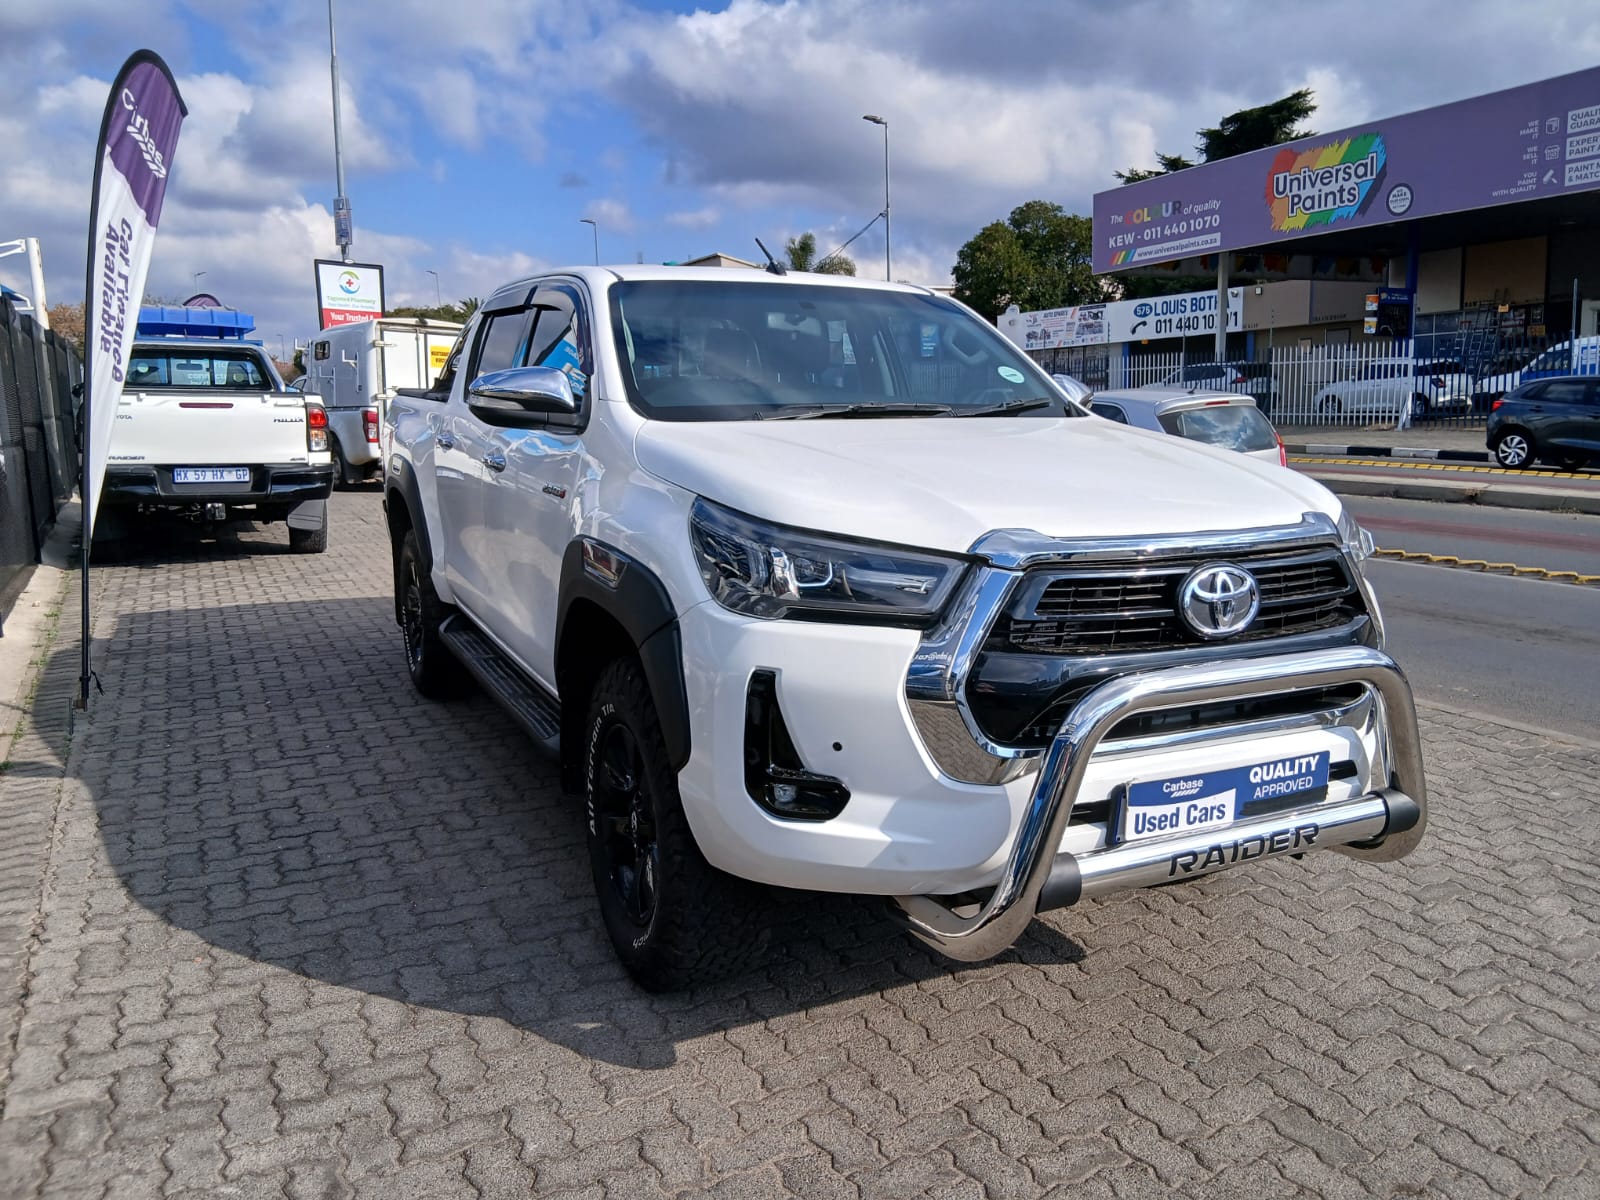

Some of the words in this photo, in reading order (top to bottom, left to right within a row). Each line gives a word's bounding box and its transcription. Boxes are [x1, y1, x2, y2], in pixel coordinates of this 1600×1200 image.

[1571, 108, 1600, 121] QUALI
[1520, 127, 1538, 136] MAKE
[1570, 135, 1600, 147] EXPER
[1569, 144, 1595, 156] PAINT
[1274, 154, 1376, 197] Universal
[1568, 162, 1595, 174] PAINT
[1492, 189, 1509, 197] WITH
[1510, 184, 1537, 195] QUALITY
[1518, 178, 1536, 186] PAINT
[1289, 184, 1358, 216] Paints
[1110, 215, 1123, 225] The
[1124, 200, 1182, 225] COLOUR
[1183, 204, 1193, 215] of
[1193, 199, 1221, 215] quality
[1108, 232, 1135, 248] KEW
[1143, 227, 1161, 241] 011
[1164, 221, 1187, 236] 440
[1190, 214, 1220, 231] 1070
[119, 217, 133, 268] Car
[1137, 237, 1217, 257] www.universalpaints.co.za
[101, 221, 120, 354] Available
[331, 312, 345, 321] Your
[345, 312, 369, 322] Trusted
[1154, 299, 1187, 316] LOUIS
[1155, 318, 1173, 334] 011
[1176, 315, 1199, 332] 440
[194, 469, 207, 481] 59
[211, 468, 225, 481] HX
[235, 468, 248, 480] GP
[1249, 755, 1320, 784] QUALITY
[1162, 778, 1204, 793] Carbase
[1253, 776, 1314, 799] APPROVED
[1134, 806, 1180, 835] Used
[1186, 802, 1226, 826] Cars
[1168, 822, 1320, 877] RAIDER
